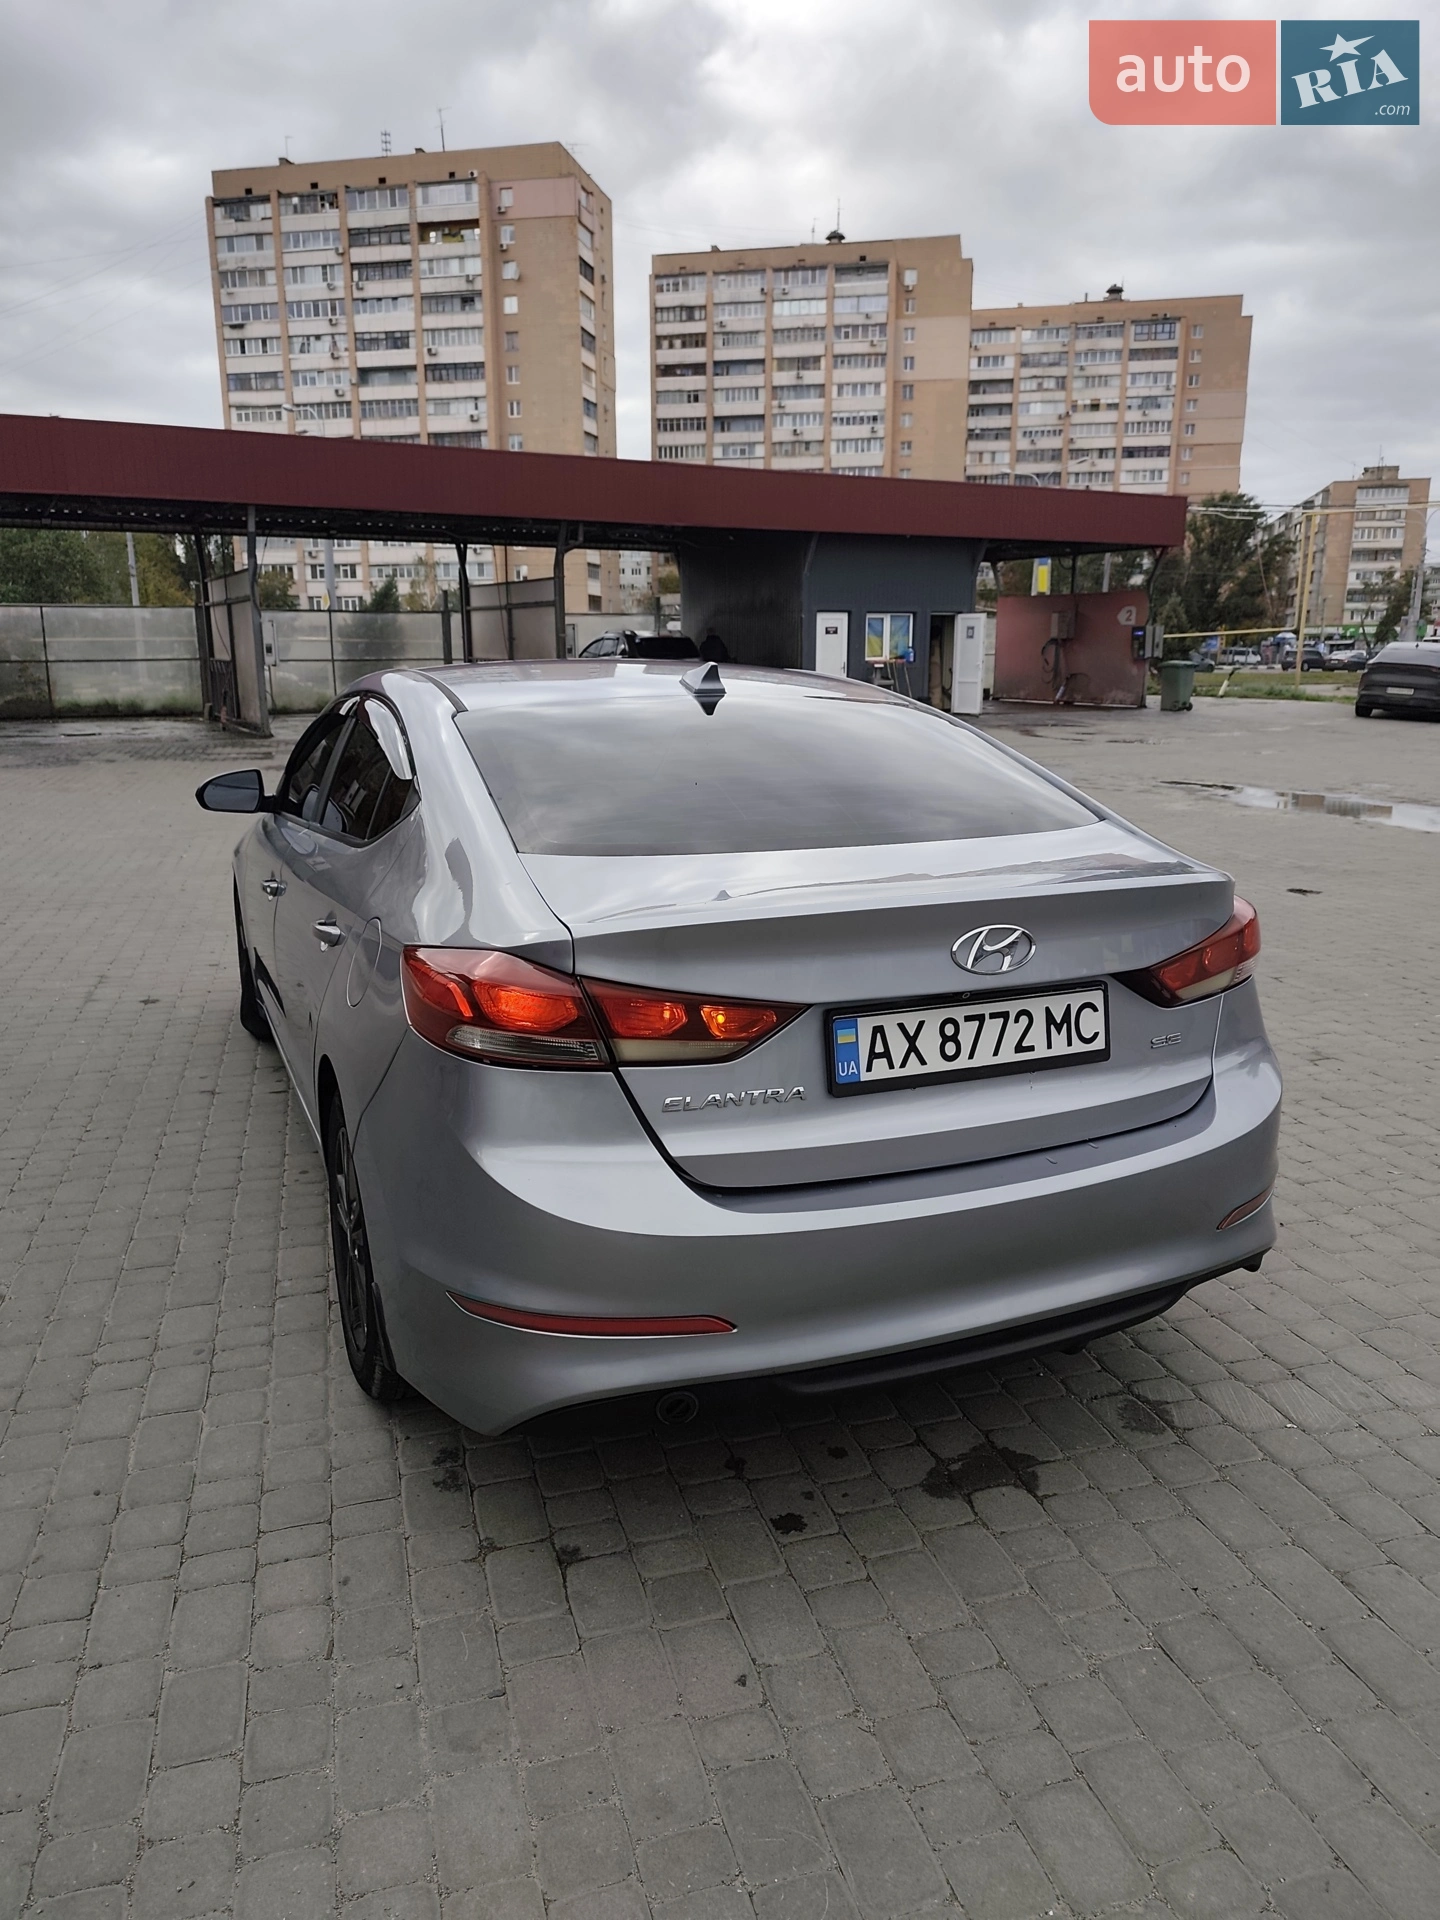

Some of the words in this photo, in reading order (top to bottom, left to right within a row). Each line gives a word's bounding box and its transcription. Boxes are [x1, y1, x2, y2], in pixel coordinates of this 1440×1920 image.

[1125, 609, 1133, 622] 2
[865, 1019, 928, 1074] AX
[938, 1008, 1036, 1063] 8772
[1045, 1000, 1100, 1050] MC
[1150, 1032, 1182, 1049] SE
[838, 1061, 859, 1077] UA
[661, 1085, 807, 1113] ELANTRA
